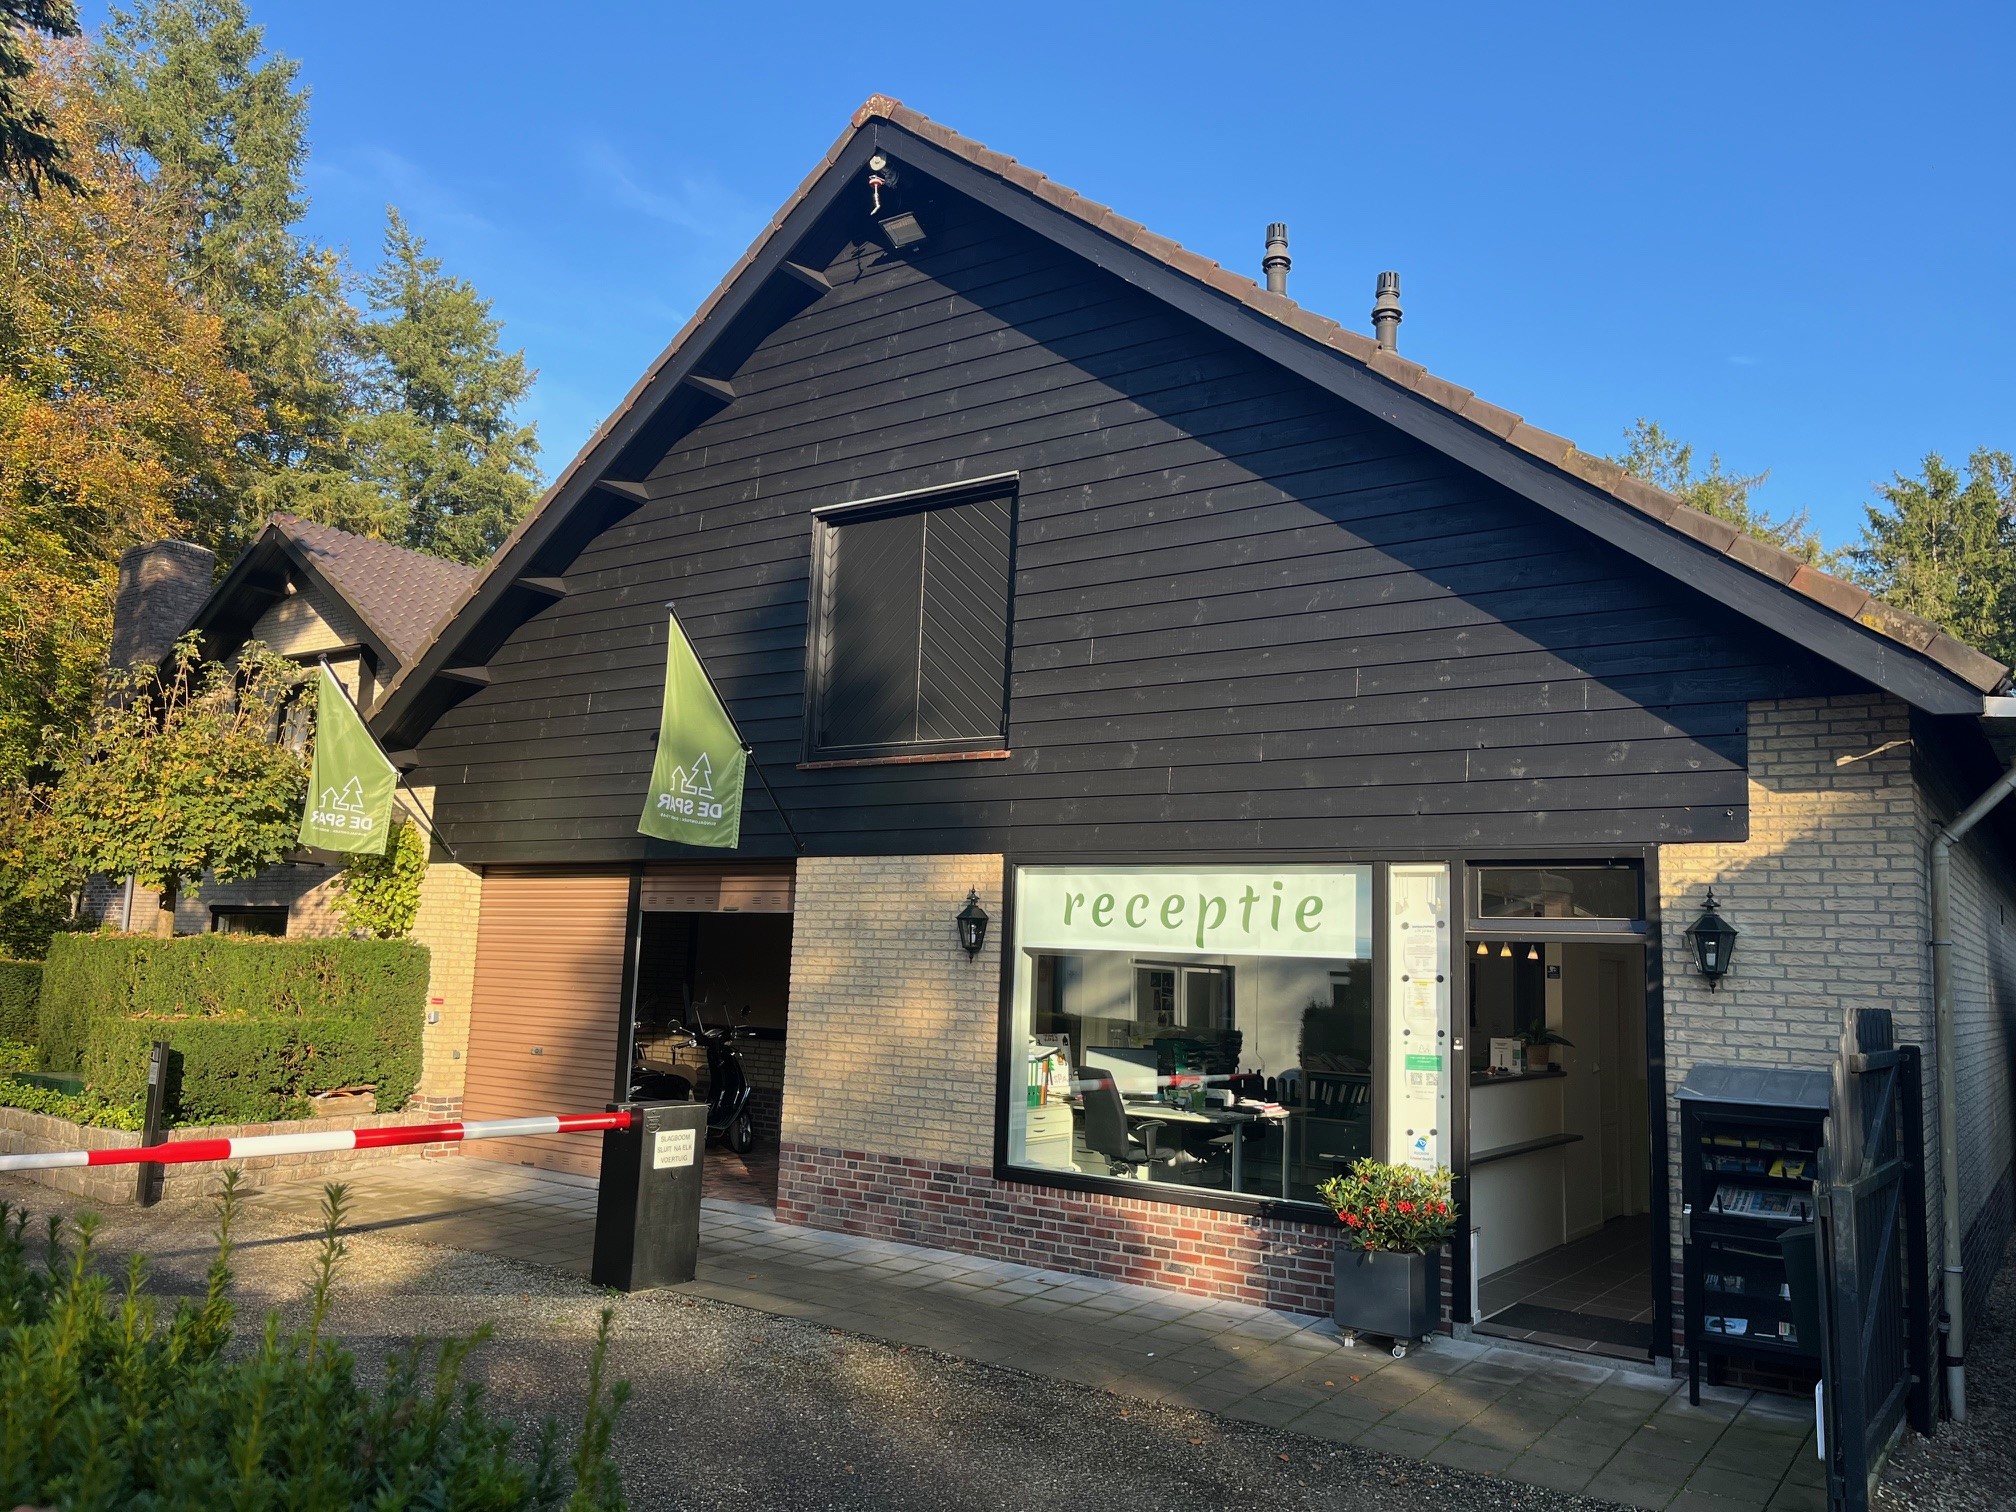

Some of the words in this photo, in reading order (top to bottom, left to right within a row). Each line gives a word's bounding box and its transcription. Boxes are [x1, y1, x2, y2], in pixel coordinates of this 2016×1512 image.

[1063, 880, 1324, 949] receptie
[661, 1134, 690, 1142] SLAGBOOM
[661, 1155, 687, 1163] VOERTUIG
